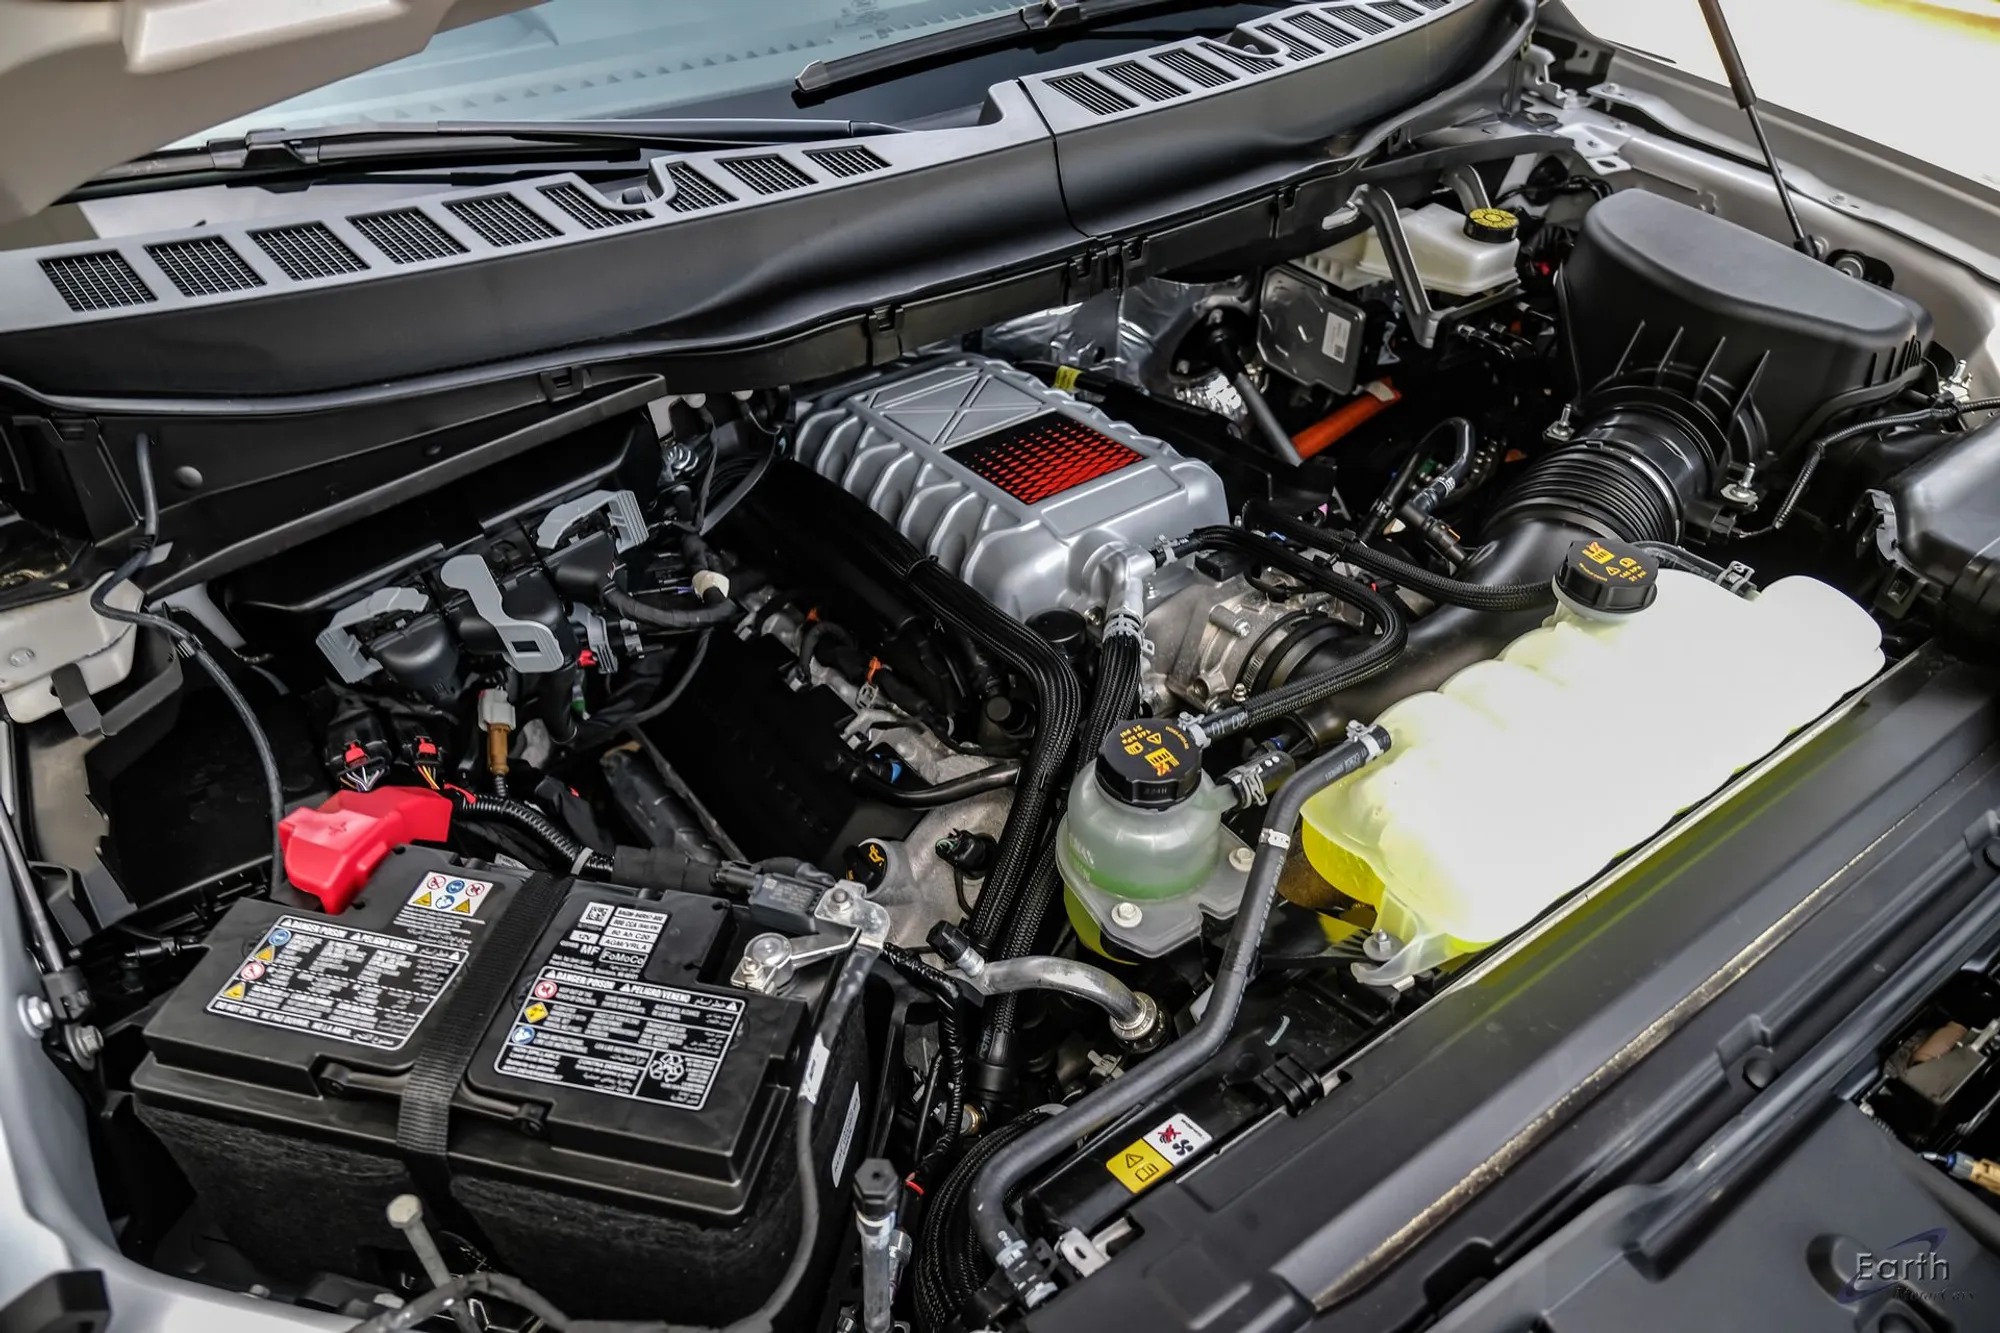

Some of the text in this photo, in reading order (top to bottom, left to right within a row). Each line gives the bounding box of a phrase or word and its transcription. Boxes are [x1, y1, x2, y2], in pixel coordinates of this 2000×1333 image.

[580, 944, 601, 955] MF
[602, 951, 645, 964] FoMoCo
[630, 985, 661, 999] PELIGRO
[661, 990, 691, 1002] VENENO
